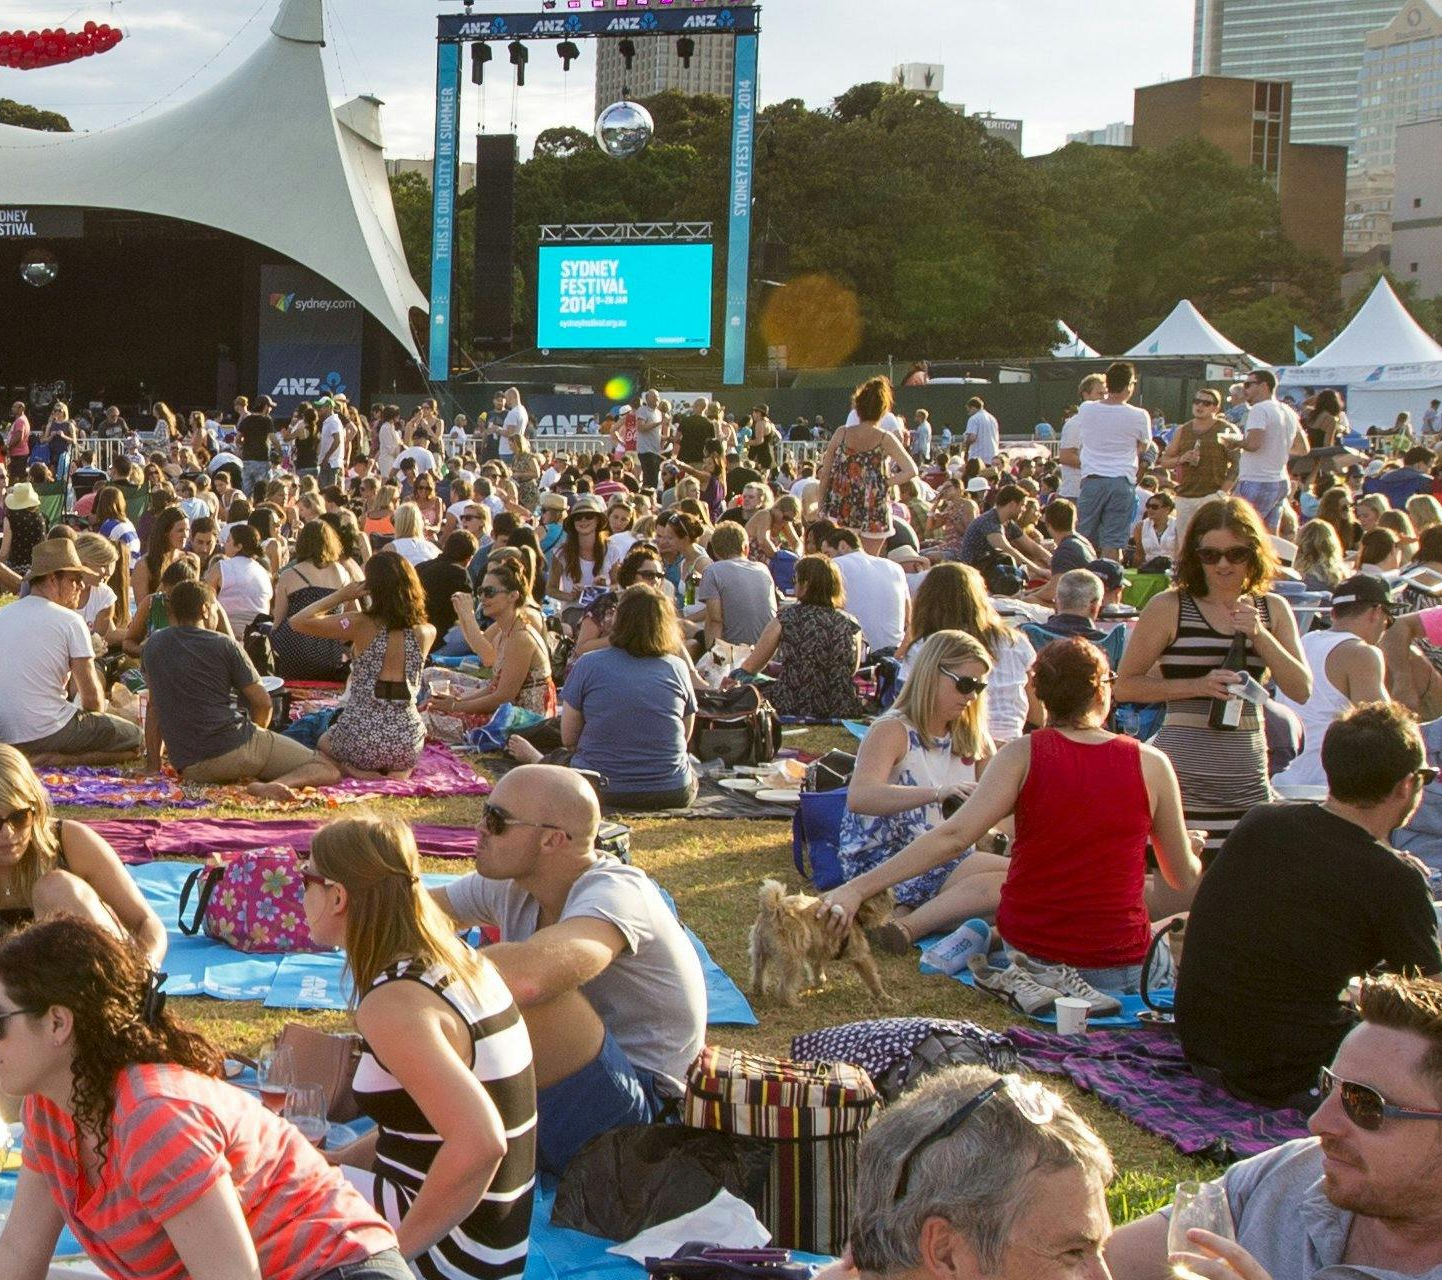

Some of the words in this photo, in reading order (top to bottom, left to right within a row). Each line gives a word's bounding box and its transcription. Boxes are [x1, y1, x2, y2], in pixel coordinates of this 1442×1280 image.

[459, 21, 491, 34] ANZ
[532, 20, 565, 32] ANZ
[607, 18, 641, 30] ANZ
[683, 15, 716, 28] ANZ
[738, 79, 751, 109] 2014
[439, 87, 454, 139] SUMMER
[439, 142, 452, 155] IN
[735, 112, 750, 167] FESTIVAL
[438, 157, 452, 186] CITY
[437, 189, 450, 214] OUR
[734, 169, 747, 216] SYDNEY
[437, 217, 449, 228] IS
[436, 230, 448, 259] THIS
[560, 260, 619, 278] SYDNEY
[560, 278, 628, 295] FESTIVAL
[295, 298, 356, 311] sydney.com
[559, 296, 594, 314] 2014
[272, 378, 320, 395] ANZ
